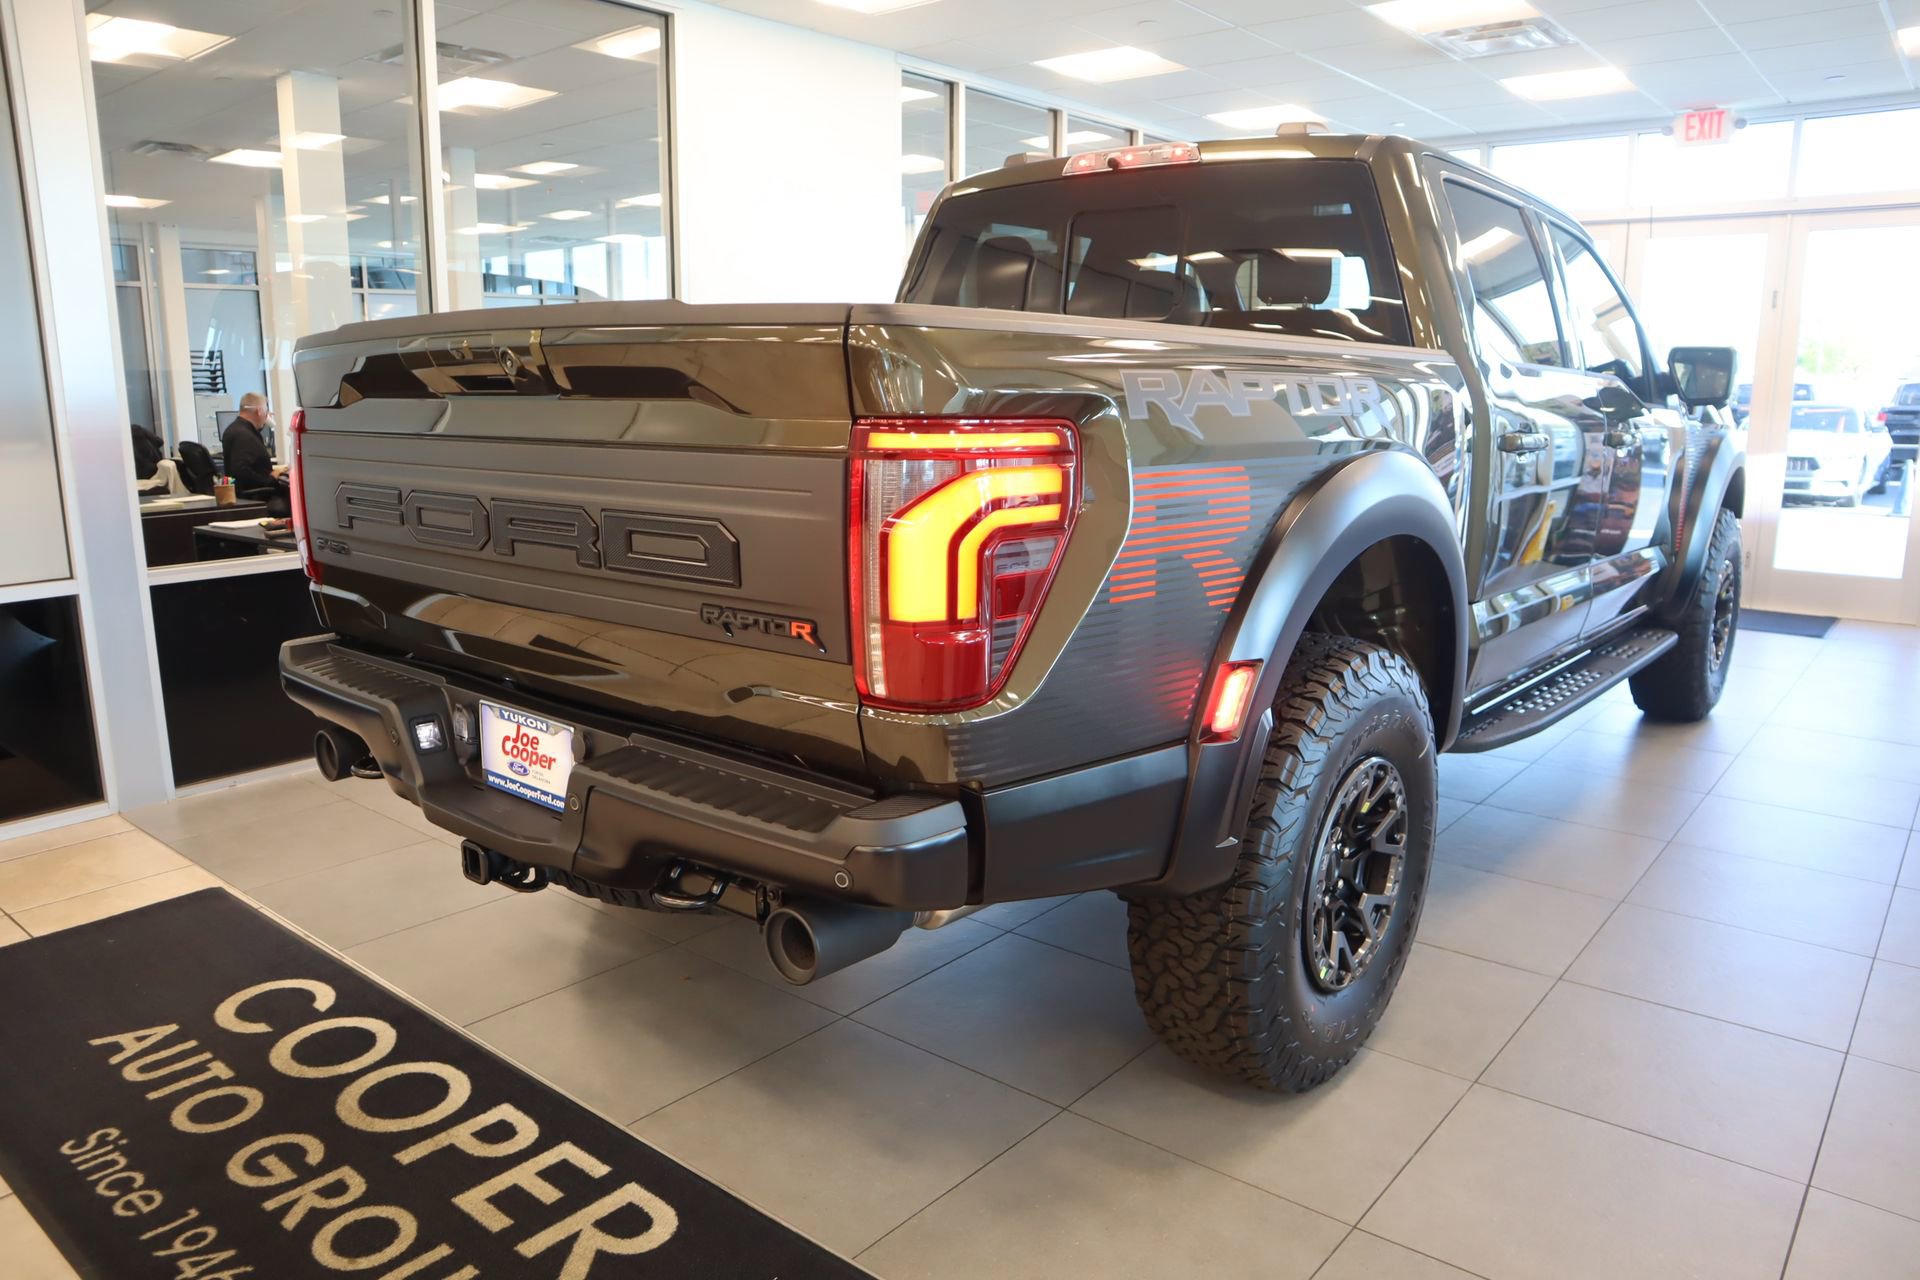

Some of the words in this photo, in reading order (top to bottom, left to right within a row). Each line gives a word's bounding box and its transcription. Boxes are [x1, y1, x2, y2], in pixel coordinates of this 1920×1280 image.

[1684, 110, 1725, 141] EXIT
[1120, 369, 1397, 440] RAPTOR
[334, 481, 742, 588] FORD
[700, 603, 827, 653] RAPTOR
[501, 709, 547, 732] YUKON
[512, 724, 539, 750] Joe
[502, 735, 556, 770] Cooper
[88, 1023, 264, 1133] AUTO
[213, 978, 679, 1280] COOPER
[60, 1127, 163, 1217] Since
